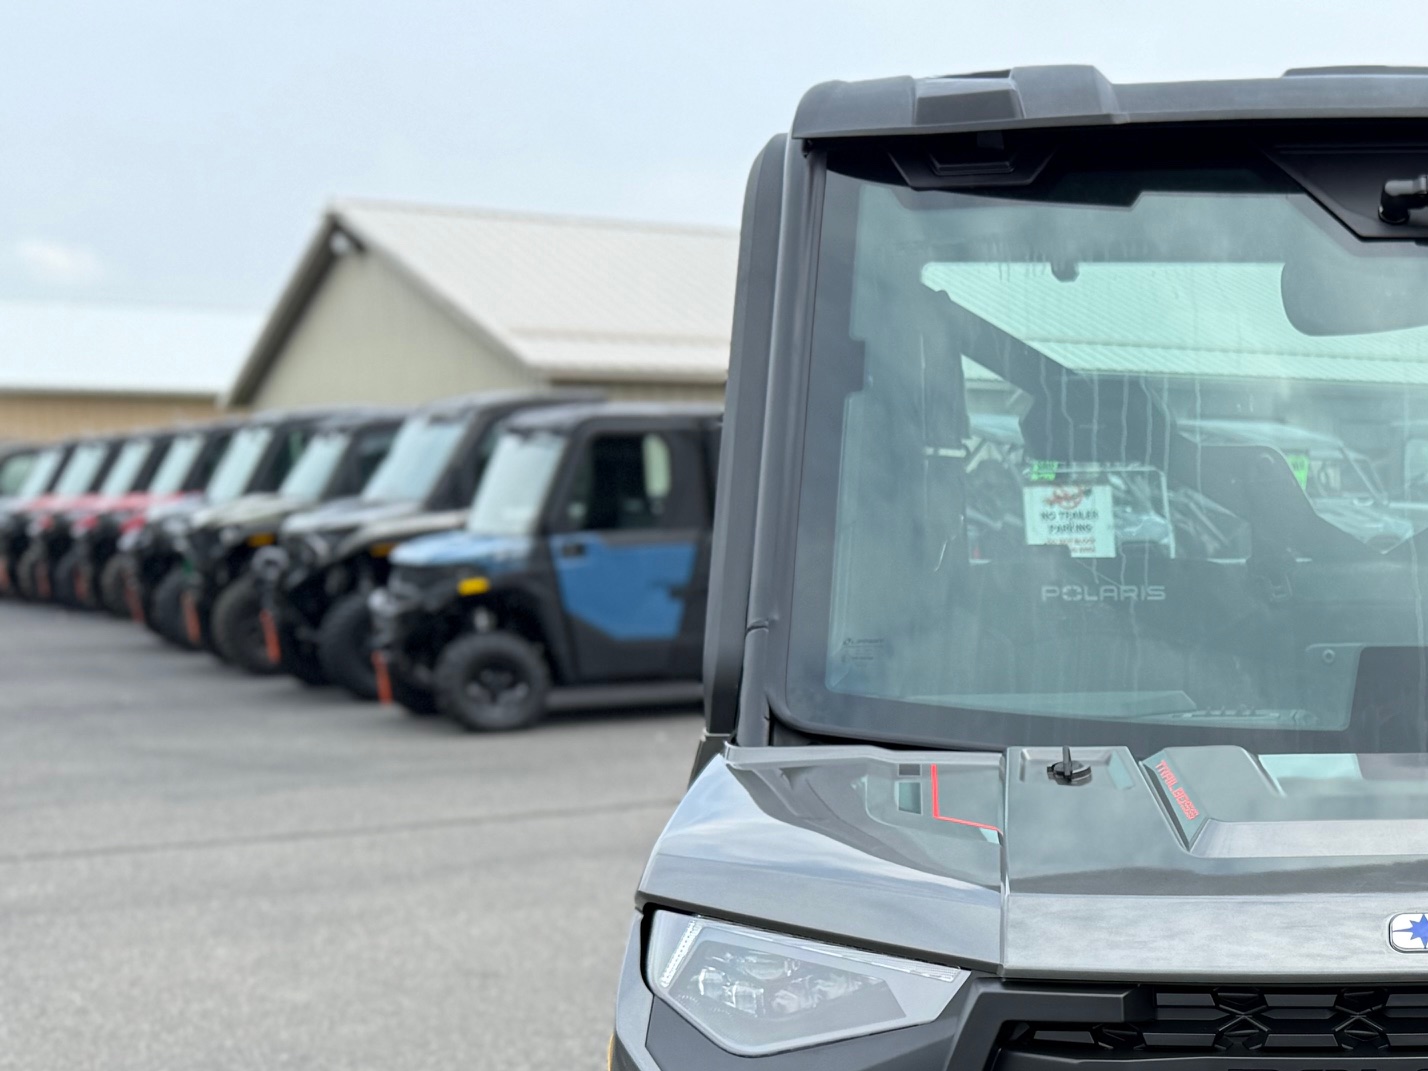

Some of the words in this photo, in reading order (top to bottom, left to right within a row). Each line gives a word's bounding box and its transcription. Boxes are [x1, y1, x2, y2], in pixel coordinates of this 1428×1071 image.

[1041, 585, 1166, 601] POLARIS
[1155, 759, 1178, 792] TRAIL
[1172, 786, 1200, 820] BOSS
